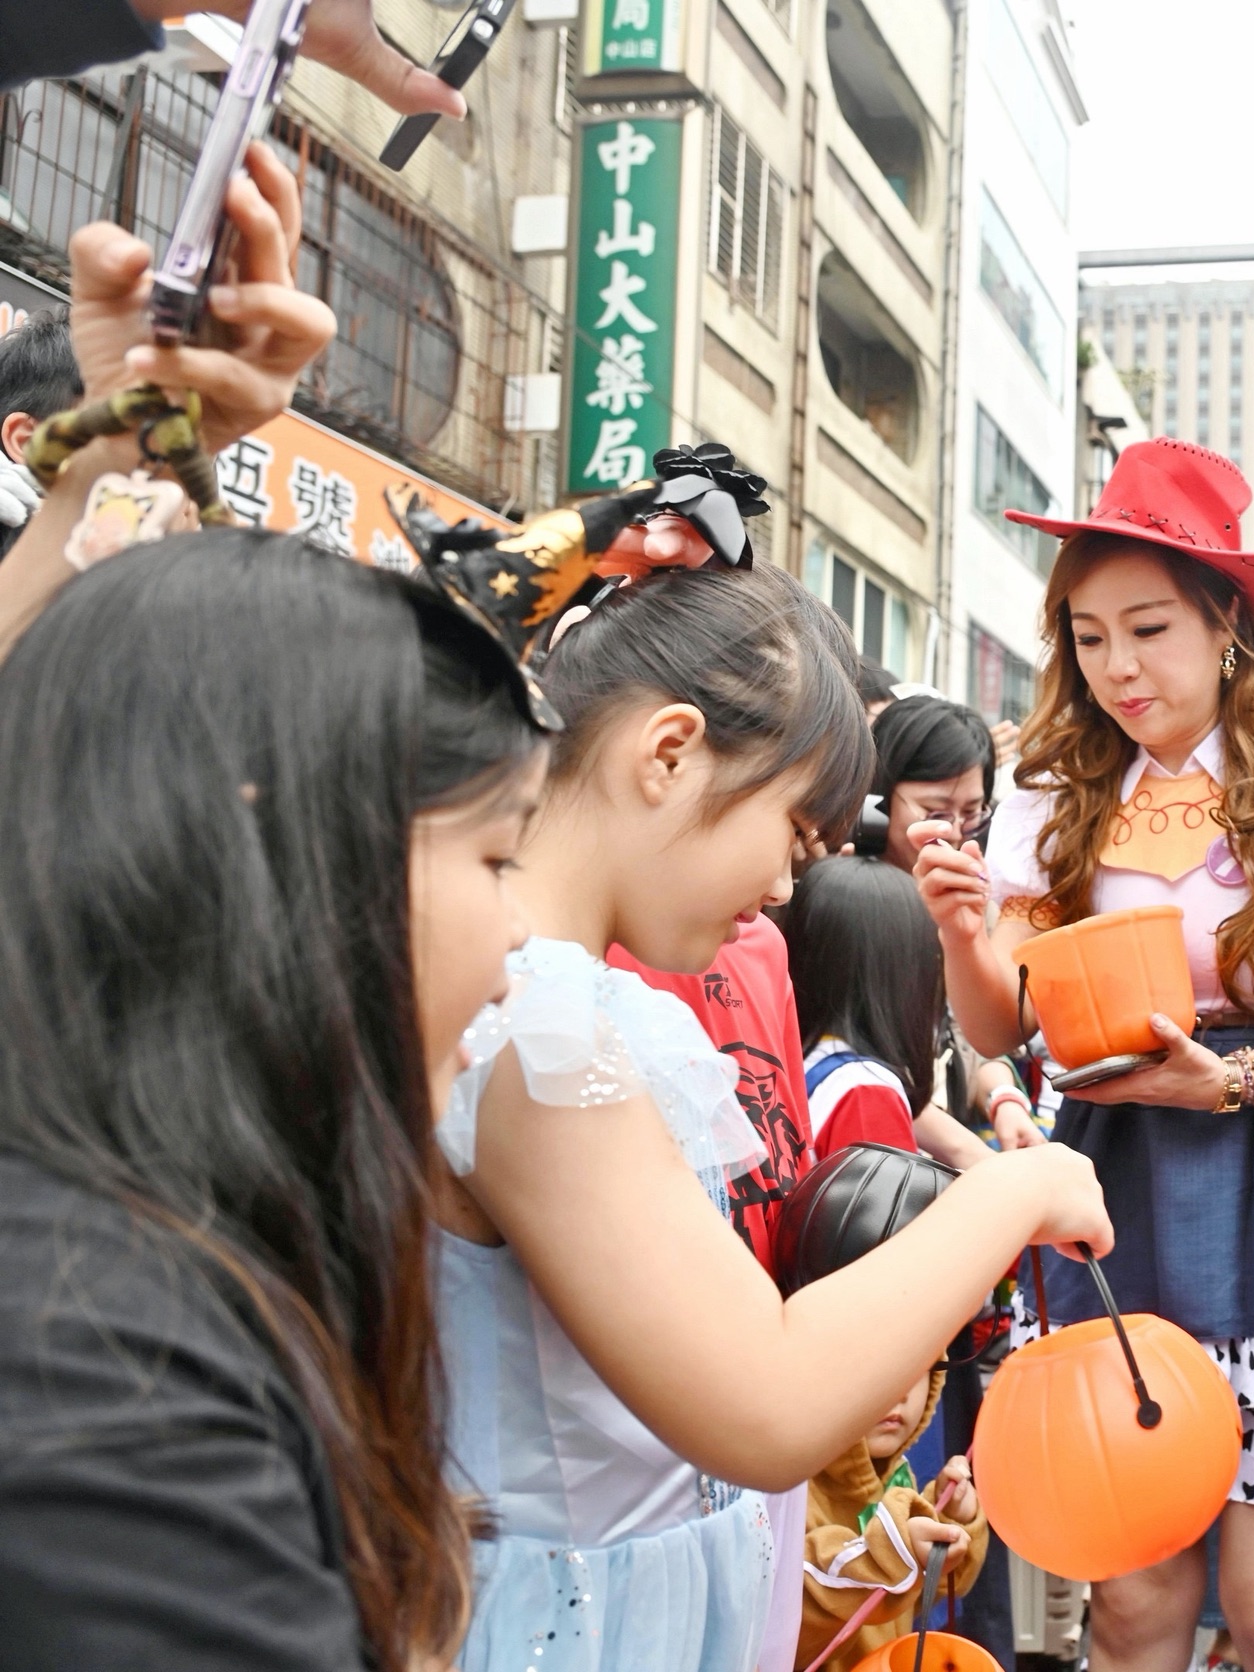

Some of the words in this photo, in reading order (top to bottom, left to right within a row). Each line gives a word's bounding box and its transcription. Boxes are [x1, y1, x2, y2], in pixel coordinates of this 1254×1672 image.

[583, 121, 659, 488] 中山大藥局
[725, 998, 743, 1009] SORT
